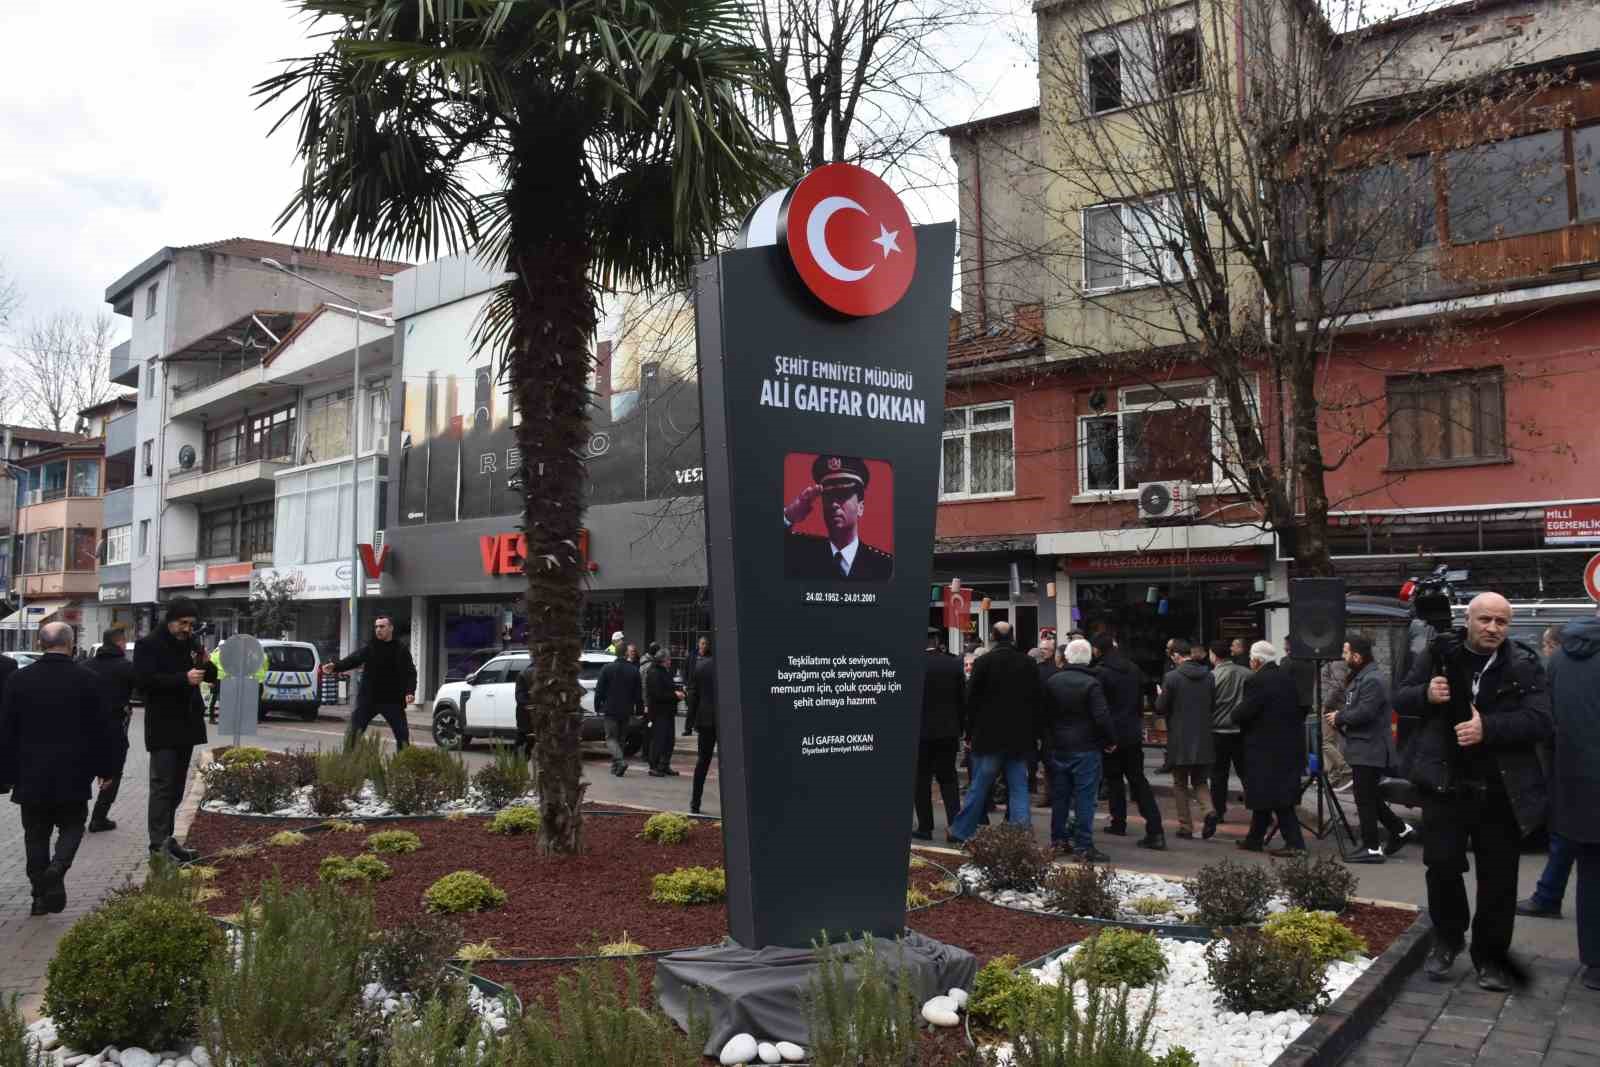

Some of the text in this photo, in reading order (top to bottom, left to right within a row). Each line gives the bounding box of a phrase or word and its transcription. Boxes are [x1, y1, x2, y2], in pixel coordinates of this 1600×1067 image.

[775, 354, 913, 391] ŞEHİT EMNİYET MÜDÜRÜ
[759, 377, 926, 425] ALİ GAFFAR OKKAN
[787, 655, 891, 668] Teşkilatımı çok seviyorum,
[777, 668, 896, 682] bayrağımı çok seviyorum. Her
[770, 684, 815, 694] memurum
[834, 682, 856, 694] çoluk
[857, 682, 886, 694] çocuğu
[888, 682, 902, 693] için
[793, 697, 814, 709] şehit
[815, 696, 845, 708] olmaya
[801, 733, 874, 746] ALİ GAFFAR OKKAN
